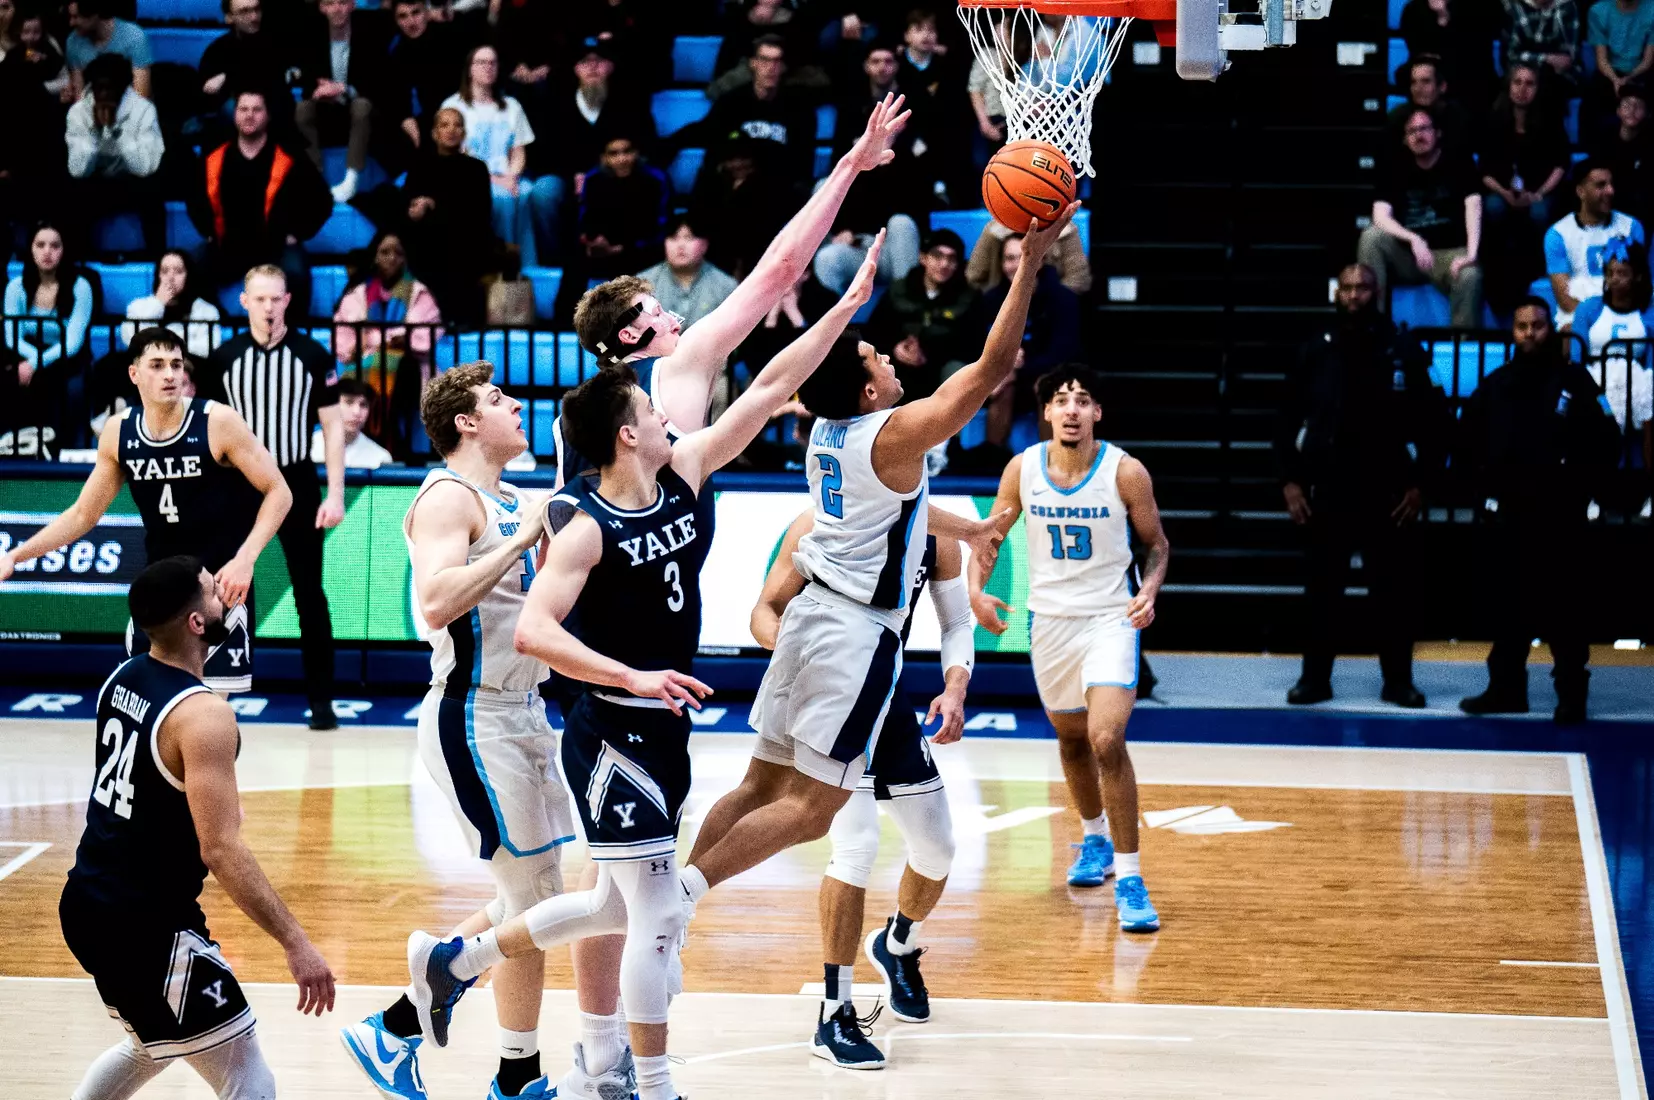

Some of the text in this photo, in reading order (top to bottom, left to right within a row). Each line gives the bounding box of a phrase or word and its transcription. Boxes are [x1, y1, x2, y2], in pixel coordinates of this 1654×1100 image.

[1032, 154, 1073, 188] ELITE
[126, 455, 202, 481] YALE
[813, 453, 845, 520] 2
[158, 483, 180, 524] 4
[1029, 503, 1111, 519] COLUMBIA
[0, 530, 123, 574] ses
[617, 512, 698, 567] YALE
[1046, 523, 1093, 561] 13
[663, 560, 685, 613] 3
[227, 648, 244, 667] Y
[92, 717, 139, 820] 24
[612, 801, 637, 829] Y
[201, 979, 229, 1008] Y
